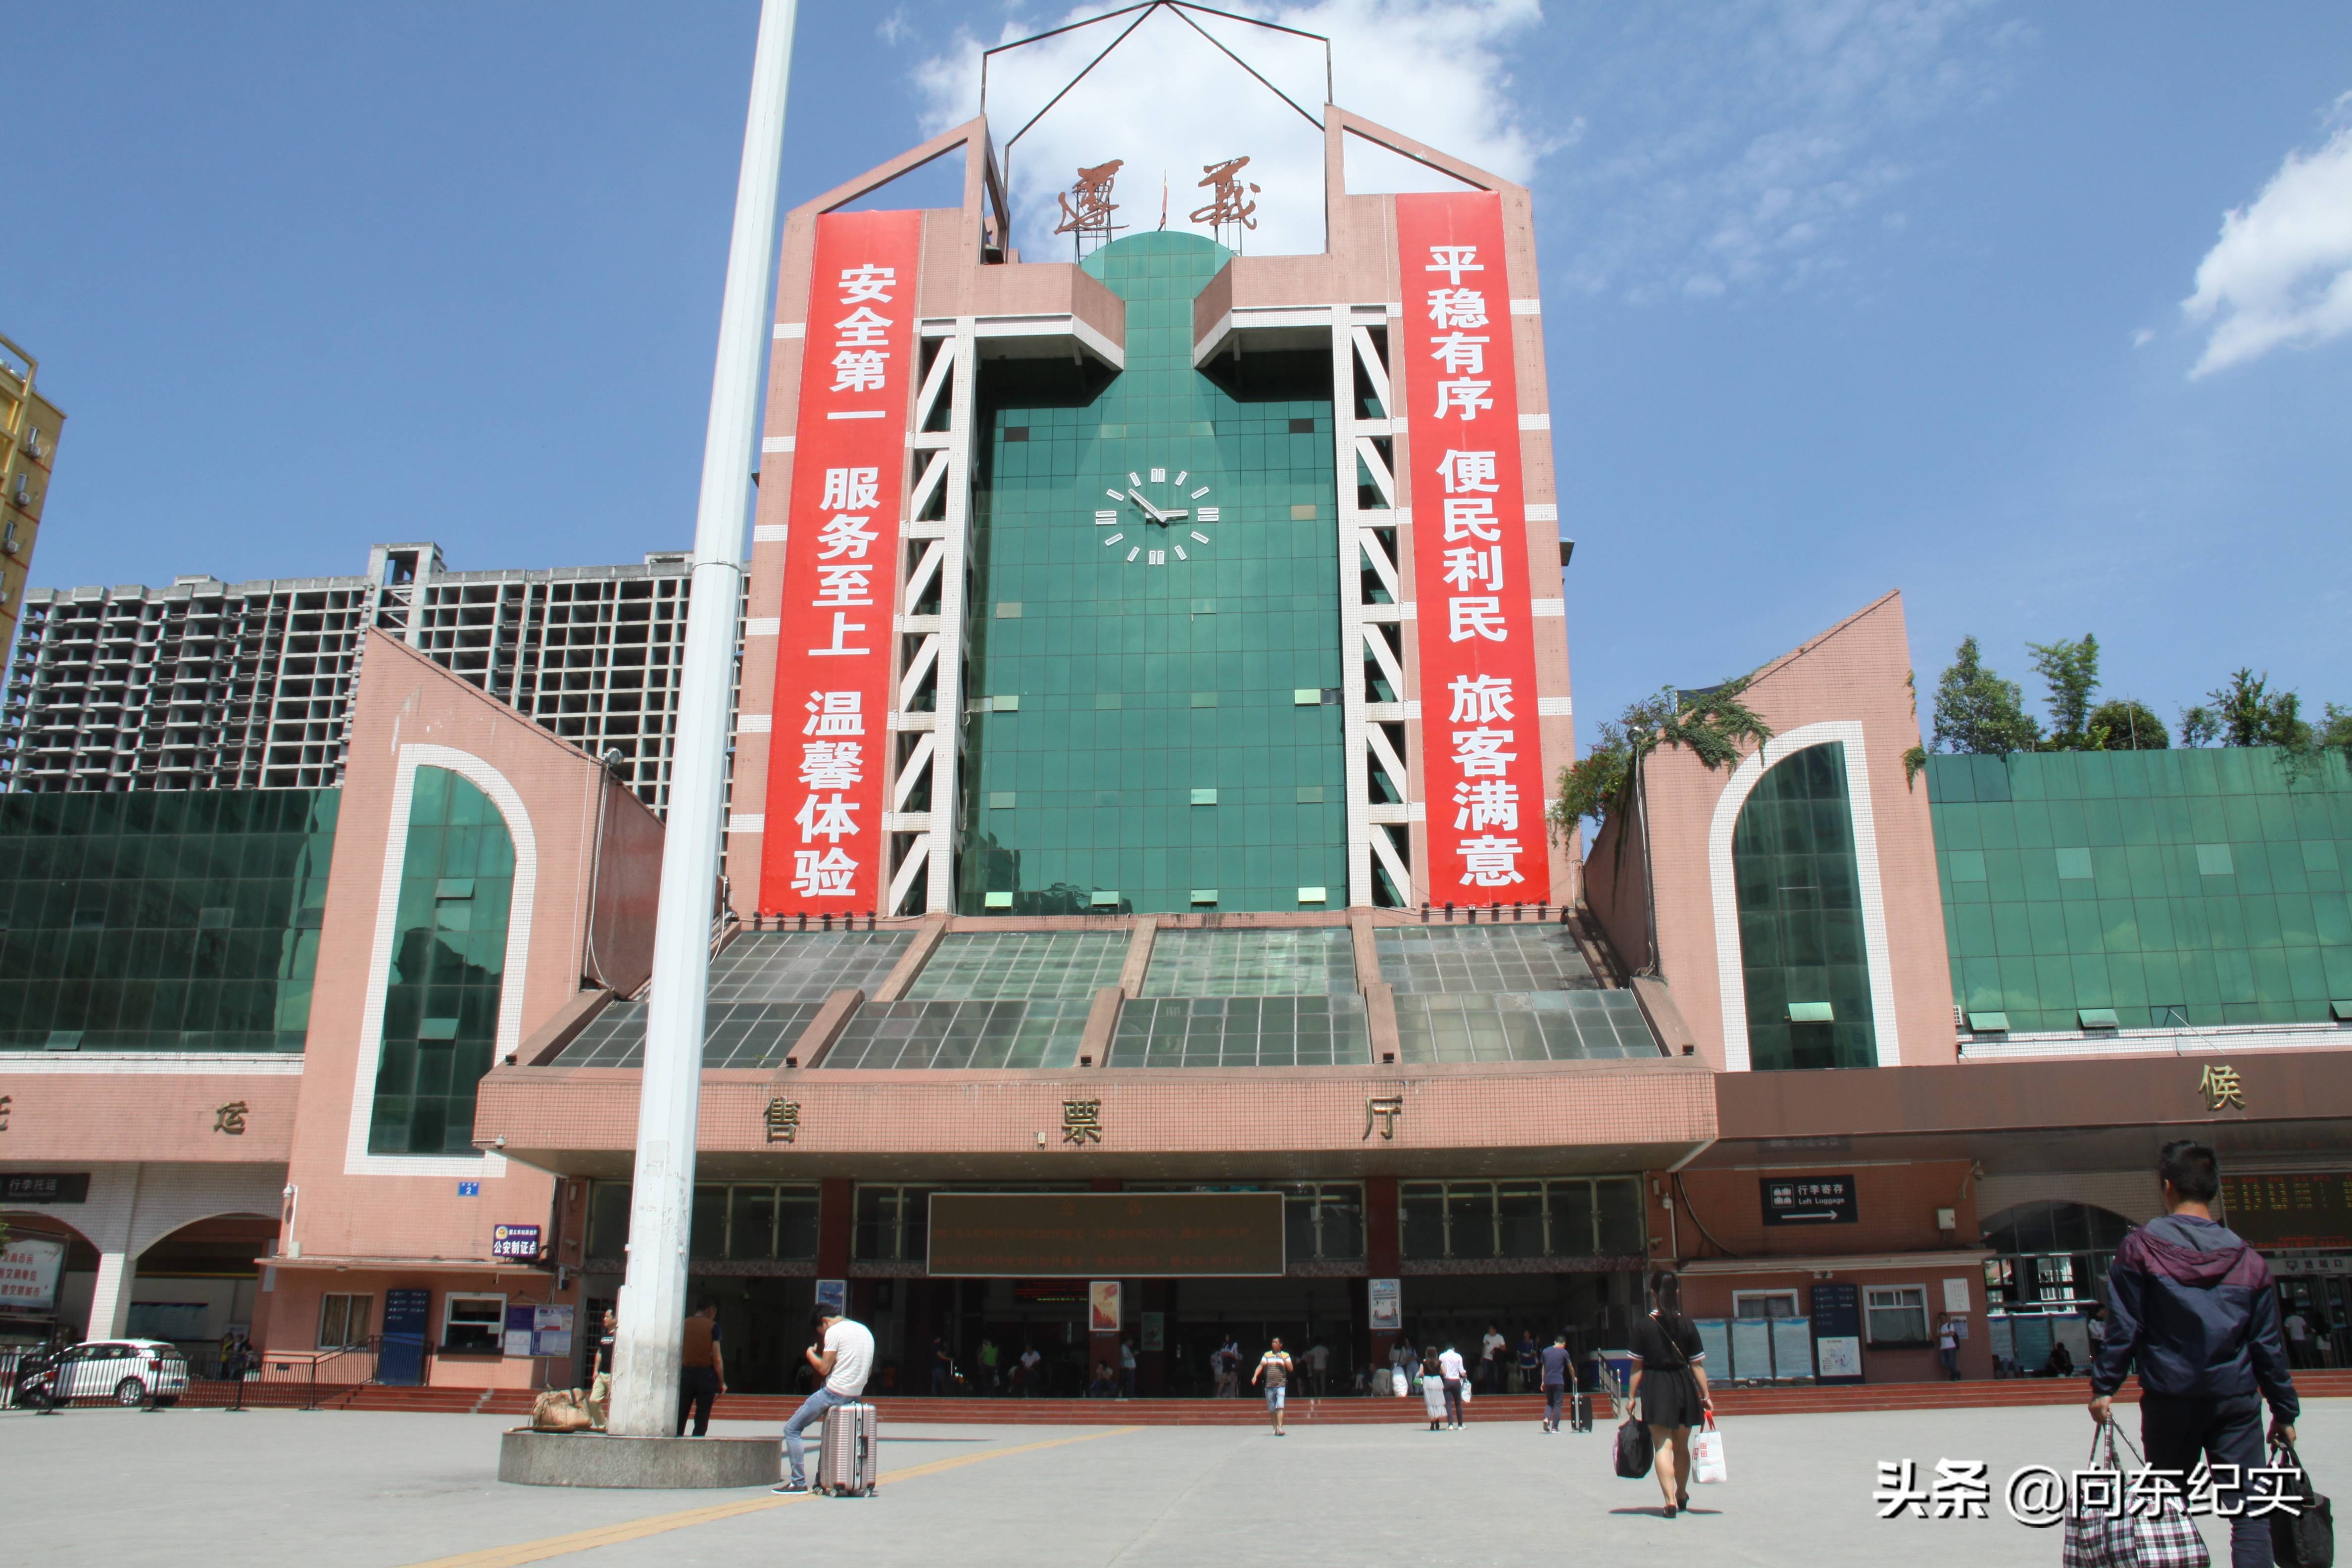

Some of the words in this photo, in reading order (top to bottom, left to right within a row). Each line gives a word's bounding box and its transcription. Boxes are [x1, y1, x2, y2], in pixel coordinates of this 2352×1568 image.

[827, 264, 896, 419] 安全第一
[1425, 246, 1493, 421] 平稳有序
[808, 467, 880, 656] 服务至上
[1436, 449, 1508, 643] 便民利民
[790, 690, 865, 897] 温馨体验
[1448, 674, 1525, 886] 旅客满意
[763, 1094, 1403, 1143] 售票厅
[2198, 1064, 2246, 1111] 候
[493, 1240, 538, 1255] 公安制证点
[1797, 1183, 1844, 1196] 行李寄存
[1815, 1197, 1845, 1205] Luggage
